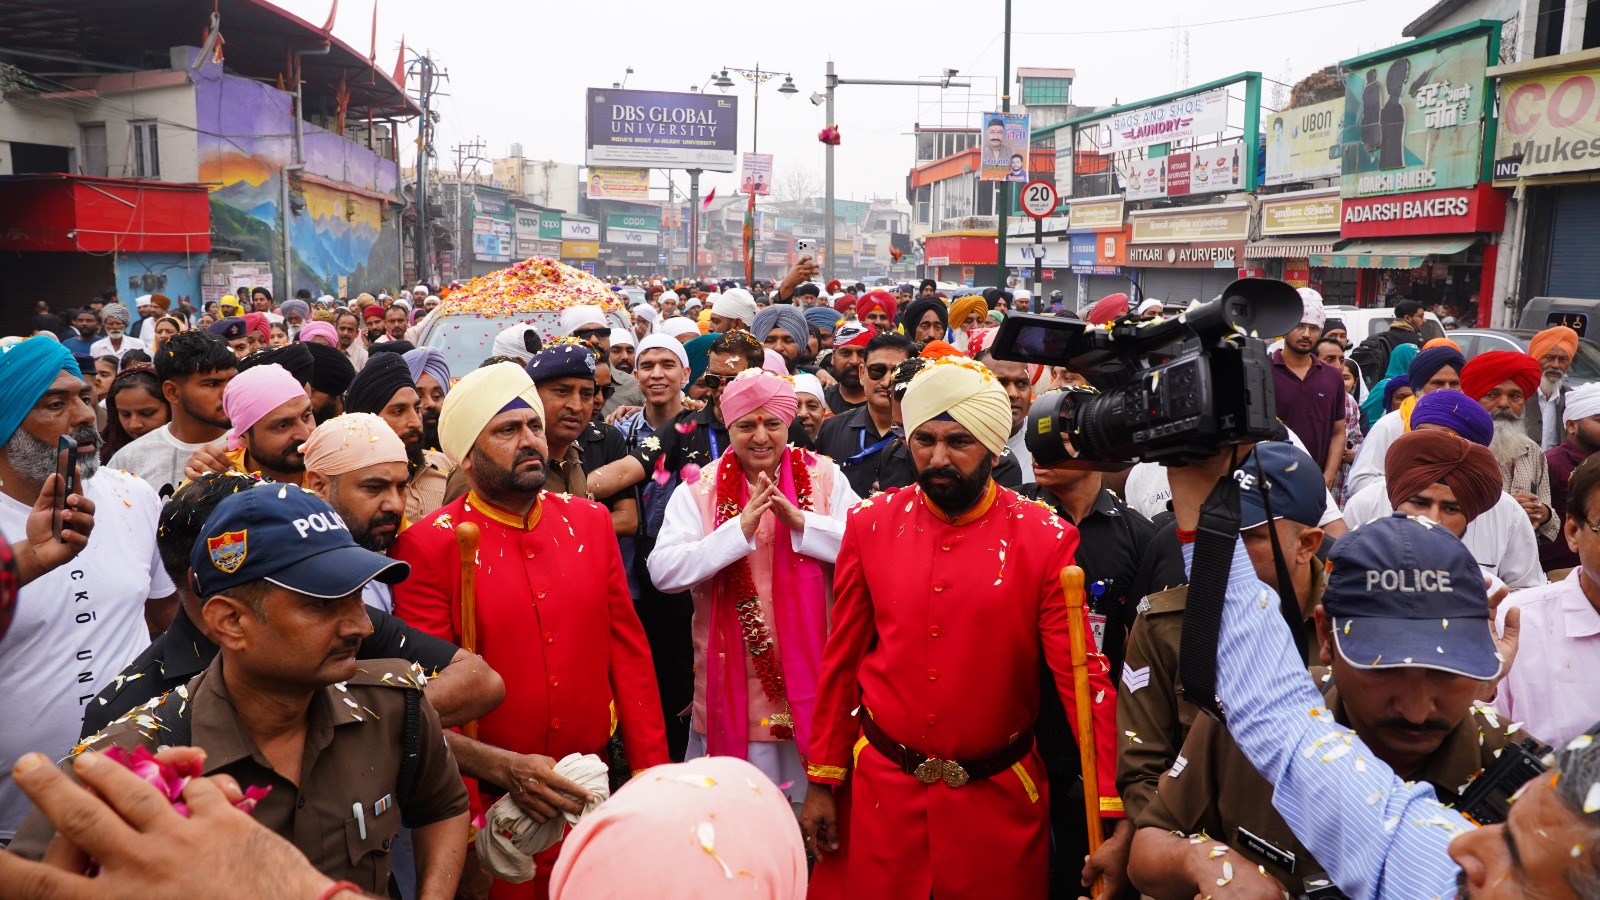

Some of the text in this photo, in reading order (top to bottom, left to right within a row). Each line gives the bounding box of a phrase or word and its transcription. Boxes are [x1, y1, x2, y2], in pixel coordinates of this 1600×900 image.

[1505, 75, 1600, 134] CO
[612, 105, 717, 125] DBS GLOBAL
[1115, 99, 1204, 130] BAGS AND SHOE
[611, 121, 718, 137] UNIVERSITY
[1131, 117, 1182, 140] LAUNDRY
[1161, 129, 1193, 141] PROFESSIONALS
[1170, 162, 1187, 170] HITKARI
[1168, 171, 1190, 179] AYURVEDIC
[1358, 173, 1394, 194] ADARSH
[1396, 169, 1437, 189] BAKERS
[1029, 186, 1050, 202] 20
[1344, 202, 1400, 223] ADARSH
[1403, 197, 1469, 219] BAKERS
[519, 217, 537, 226] oppo
[541, 220, 560, 229] oppo
[571, 223, 591, 234] vivo
[623, 217, 644, 227] oppo
[625, 231, 642, 241] vivo
[1072, 245, 1095, 253] SAMSUNG
[1130, 246, 1235, 262] HITKARI AYURVEDIC
[1366, 569, 1453, 592] POLICE
[70, 569, 97, 711] CKŌ UNL
